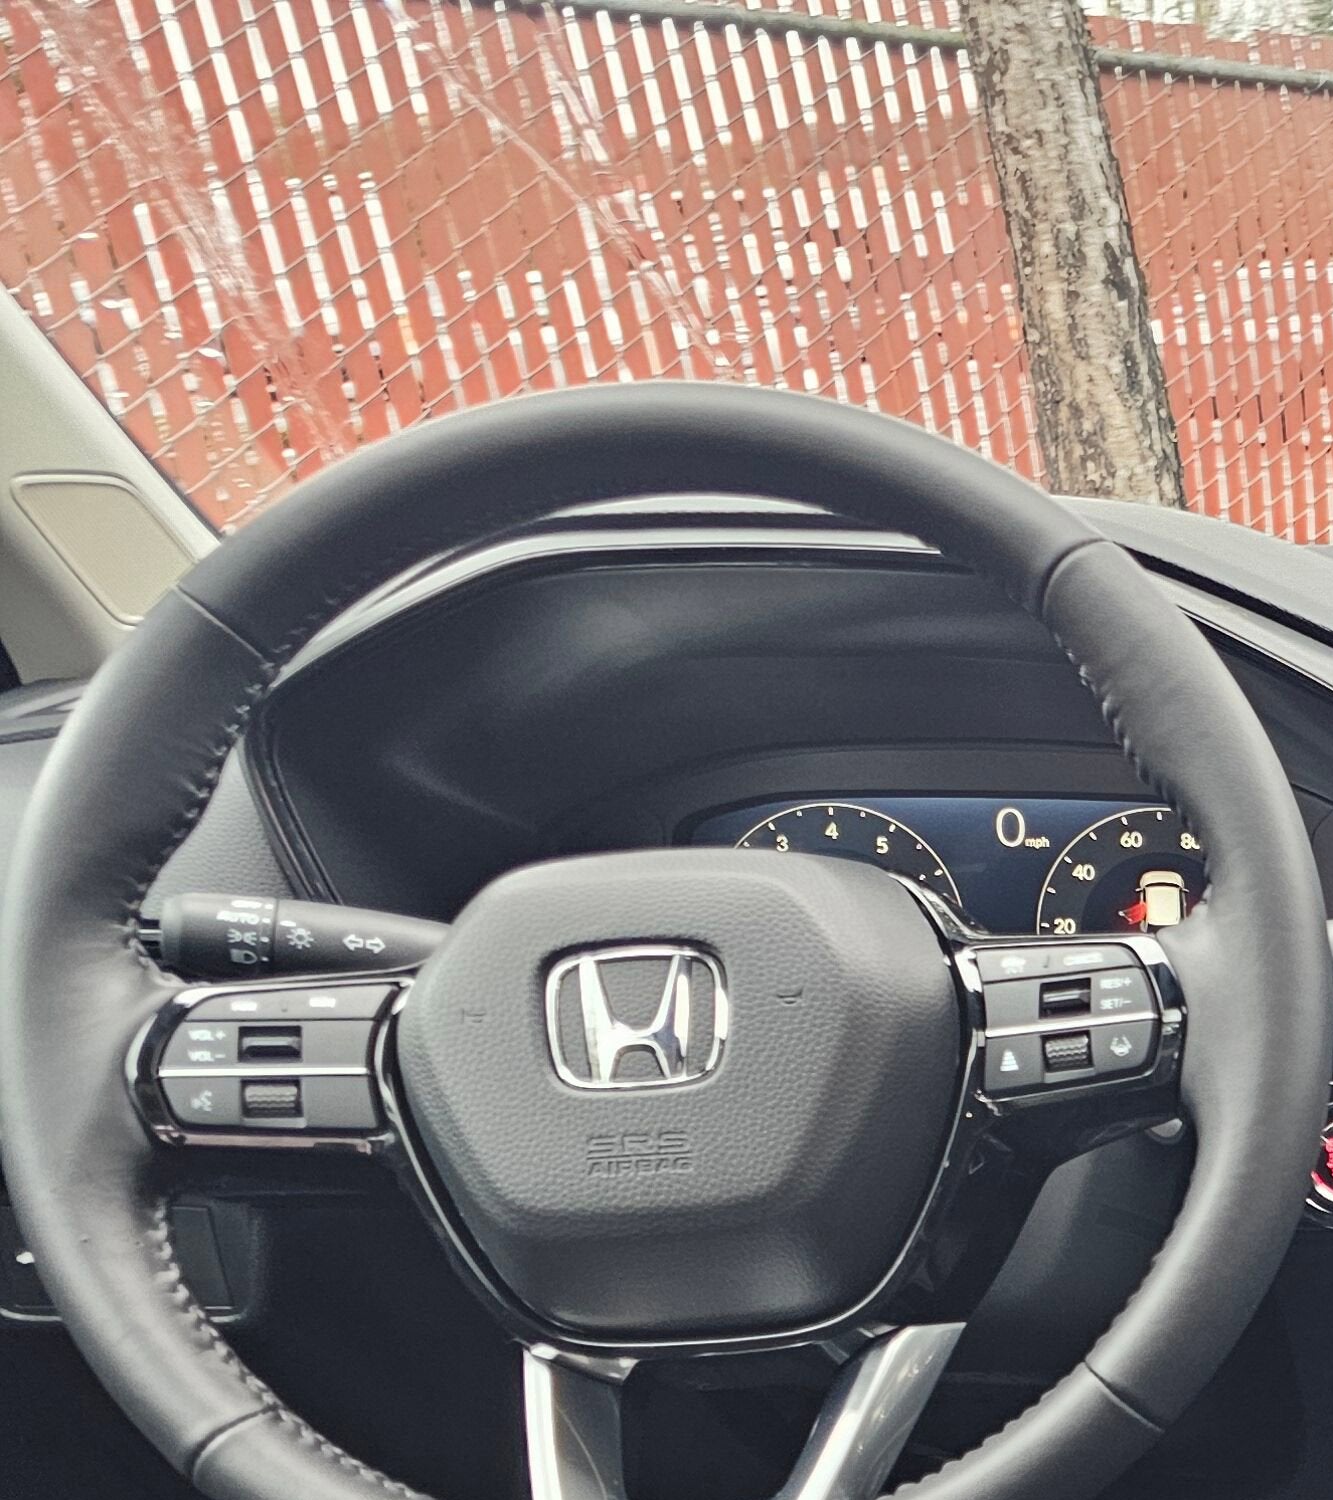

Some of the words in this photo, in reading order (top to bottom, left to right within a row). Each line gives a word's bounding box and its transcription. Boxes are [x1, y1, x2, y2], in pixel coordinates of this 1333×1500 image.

[825, 824, 839, 840] 4
[996, 808, 1026, 848] 0
[1025, 837, 1050, 851] mph
[777, 836, 789, 852] 3
[876, 837, 889, 855] 5
[1121, 831, 1143, 849] 60
[1072, 863, 1096, 881] 40
[1053, 918, 1077, 935] 20
